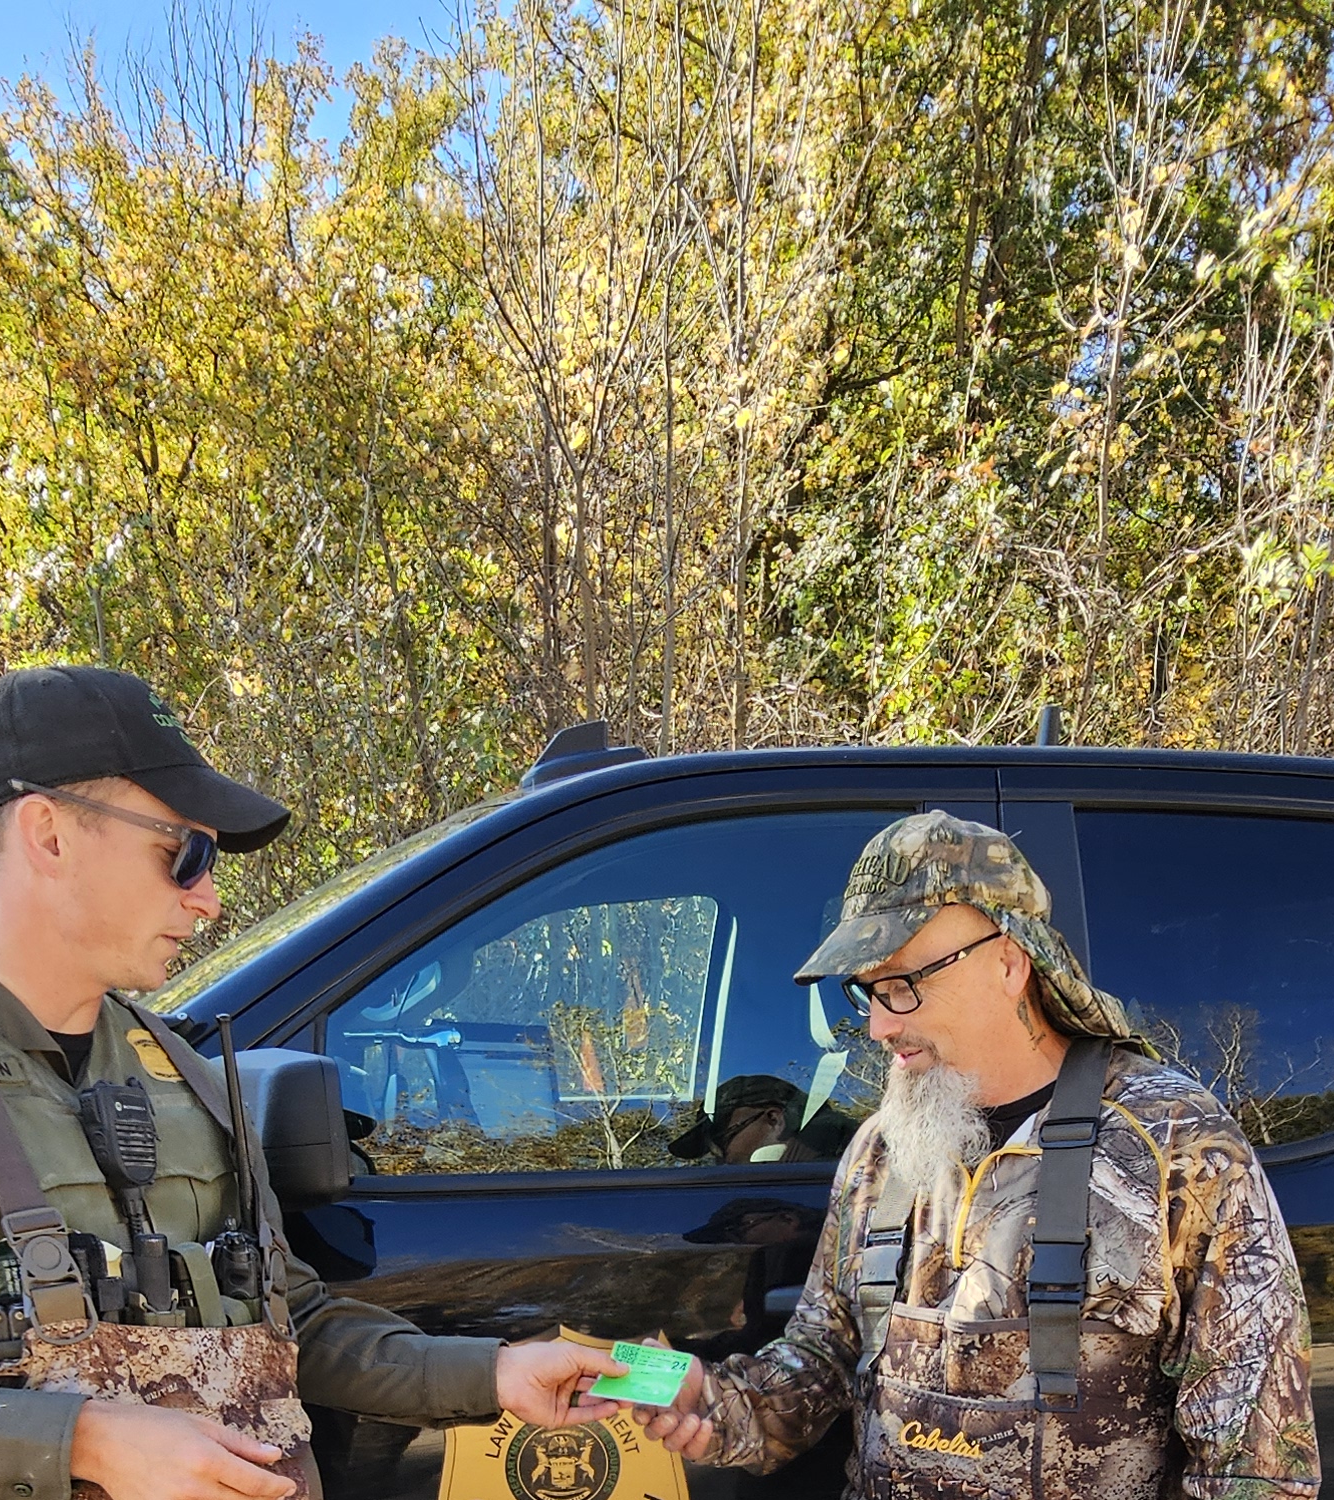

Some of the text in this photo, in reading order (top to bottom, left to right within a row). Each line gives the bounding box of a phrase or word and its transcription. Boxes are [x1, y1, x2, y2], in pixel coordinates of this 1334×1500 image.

[485, 1417, 514, 1459] LAW
[899, 1420, 983, 1459] Cabela's
[507, 1427, 531, 1497] DEPARTMENT
